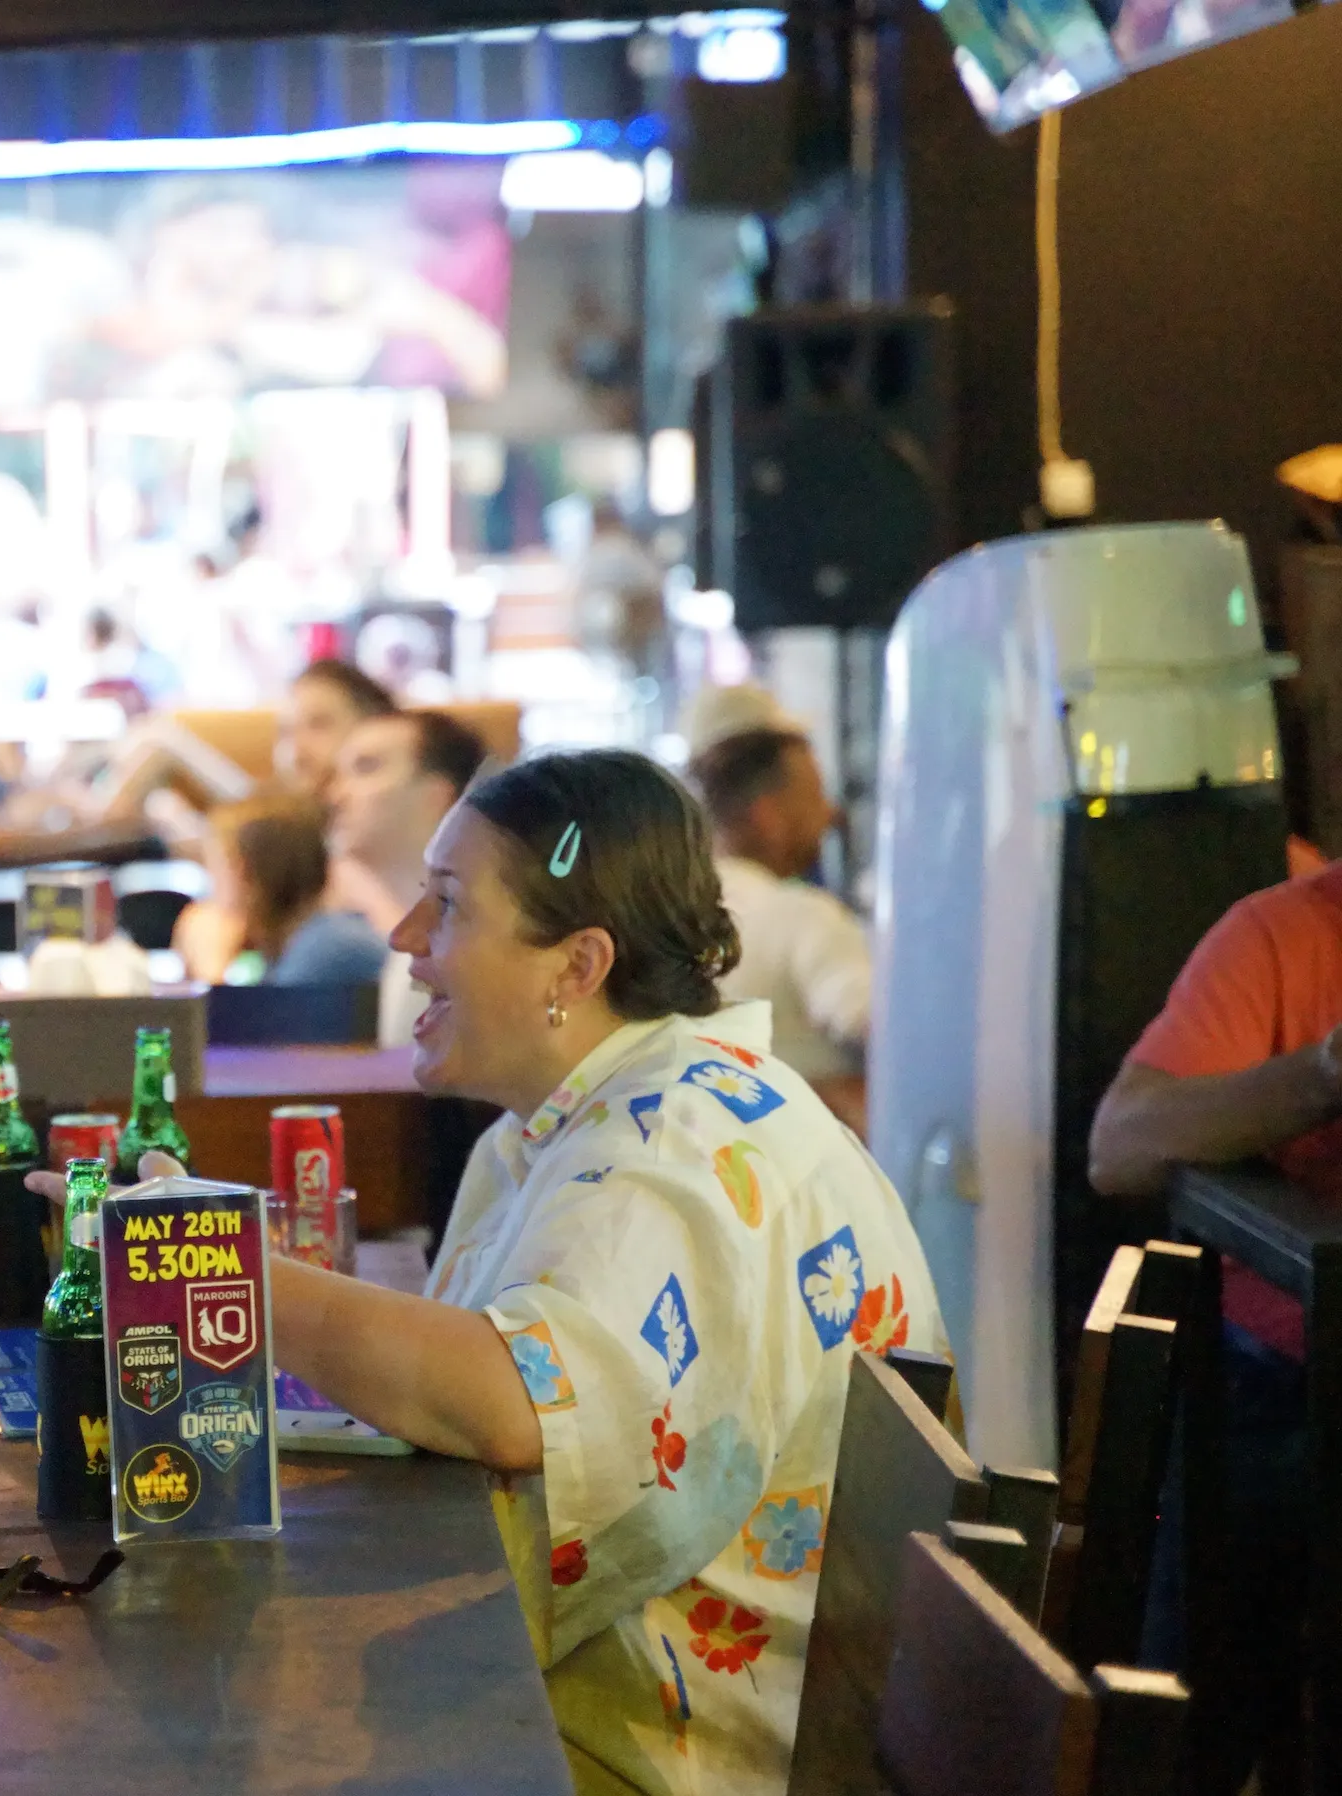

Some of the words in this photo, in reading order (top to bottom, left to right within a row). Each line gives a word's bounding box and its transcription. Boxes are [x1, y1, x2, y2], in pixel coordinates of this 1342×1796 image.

[124, 1215, 174, 1241] MAY
[183, 1210, 241, 1238] 28TH
[127, 1243, 243, 1282] 5.30PM
[193, 1290, 248, 1302] MAROONS
[125, 1325, 173, 1337] AMPOL
[128, 1346, 156, 1356] STATE
[157, 1345, 170, 1354] OF
[123, 1352, 176, 1367] ORIGIN
[203, 1405, 228, 1414] STATE
[179, 1409, 263, 1440] ORIGIN
[133, 1472, 189, 1498] WINX
[137, 1495, 168, 1507] Sports
